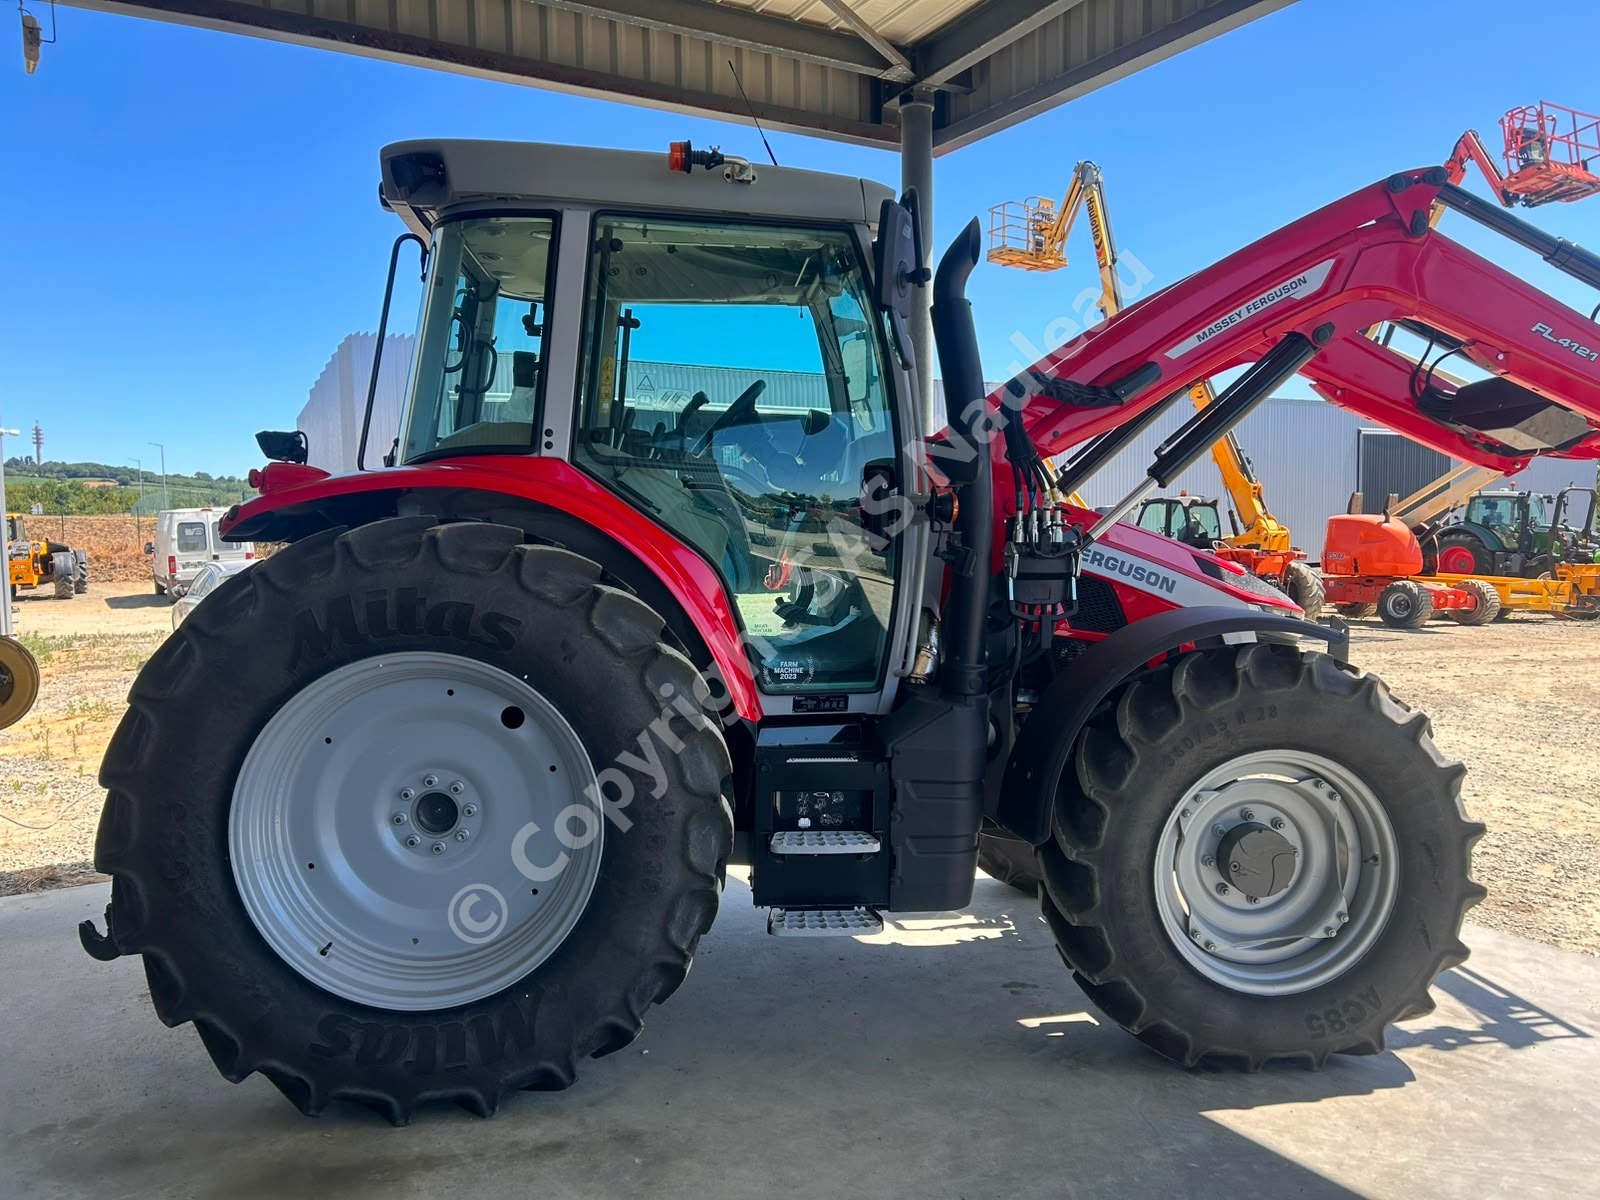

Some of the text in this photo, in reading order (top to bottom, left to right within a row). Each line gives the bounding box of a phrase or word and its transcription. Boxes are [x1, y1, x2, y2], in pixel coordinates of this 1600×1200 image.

[1086, 195, 1101, 241] Haulotte
[1196, 275, 1308, 343] MASSEY FERGUSON
[1530, 322, 1599, 362] FL.4121
[290, 587, 522, 668] Mitas
[310, 987, 543, 1077] Mitas
[1304, 984, 1383, 1040] AC85
